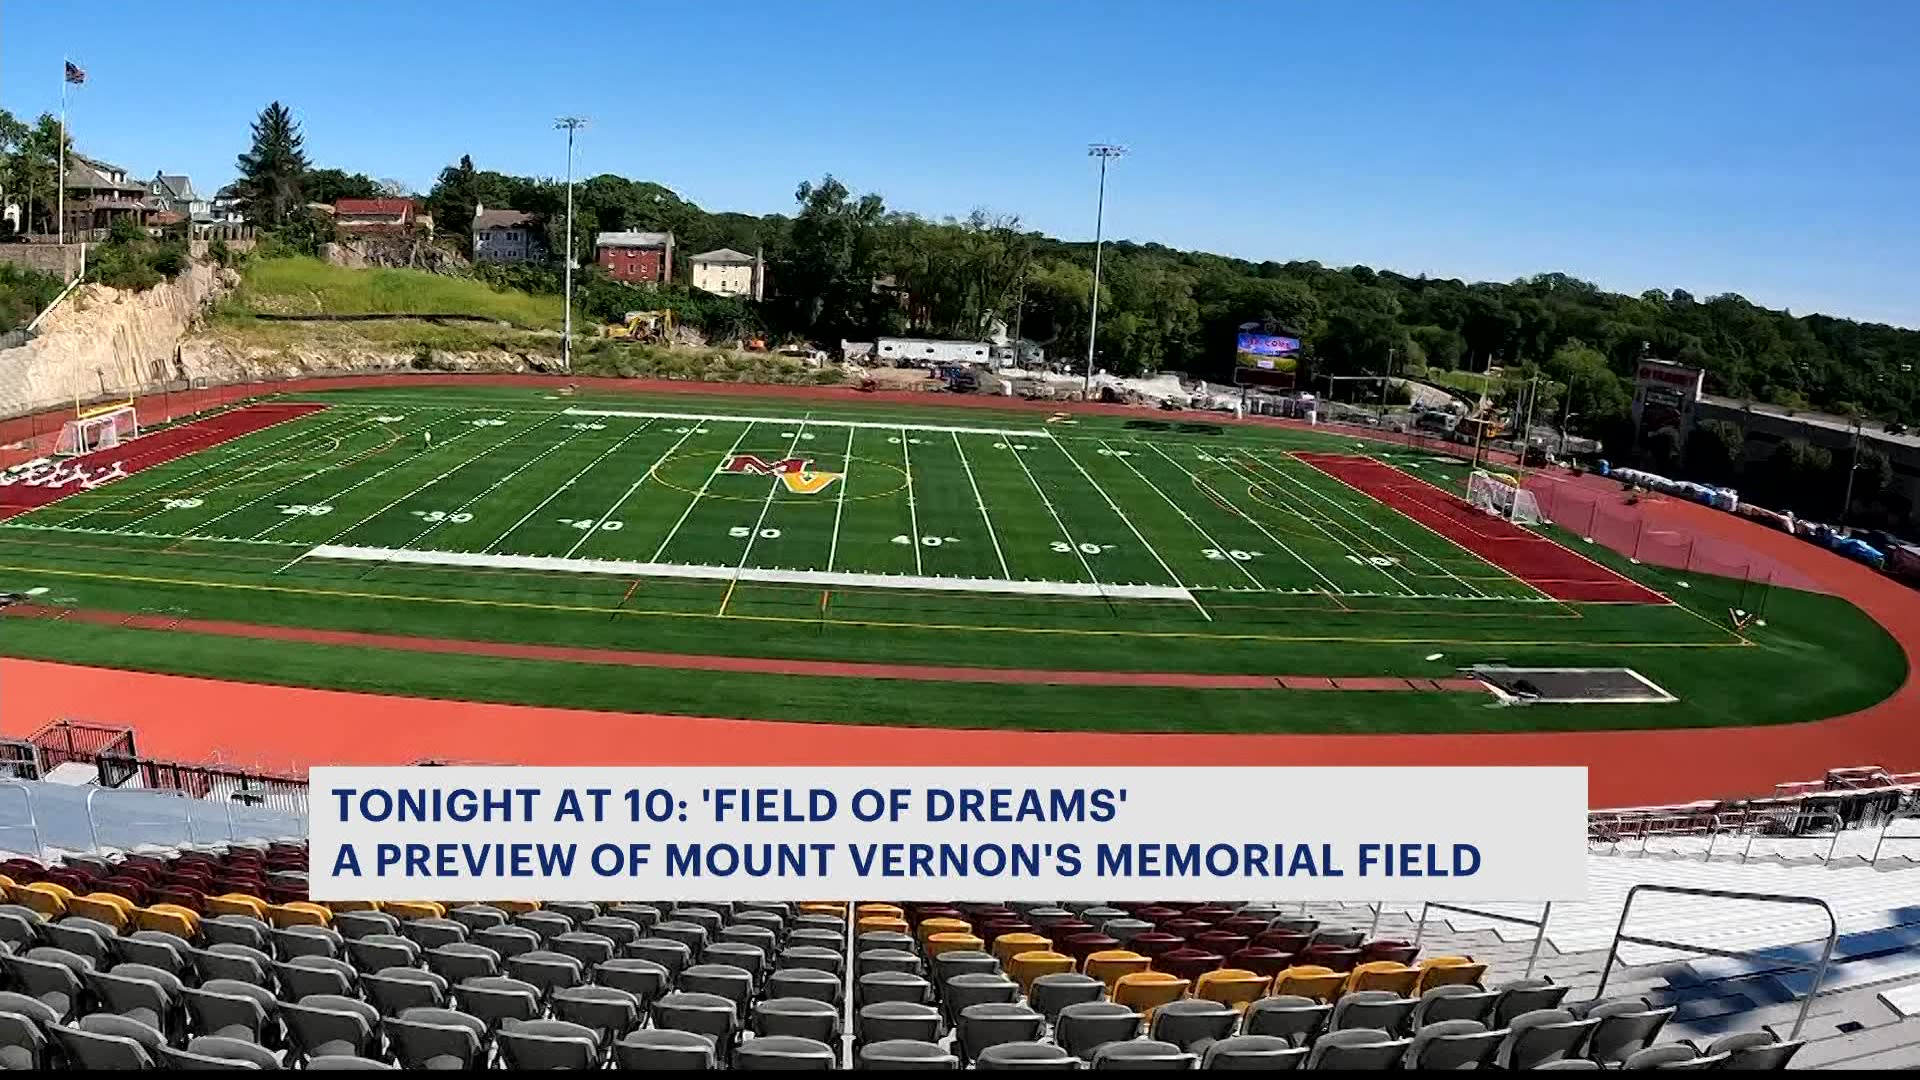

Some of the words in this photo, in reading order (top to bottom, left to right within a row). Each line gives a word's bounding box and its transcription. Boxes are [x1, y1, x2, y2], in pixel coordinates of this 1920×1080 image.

[571, 519, 625, 532] 40
[727, 526, 782, 539] 50
[890, 535, 943, 547] 40
